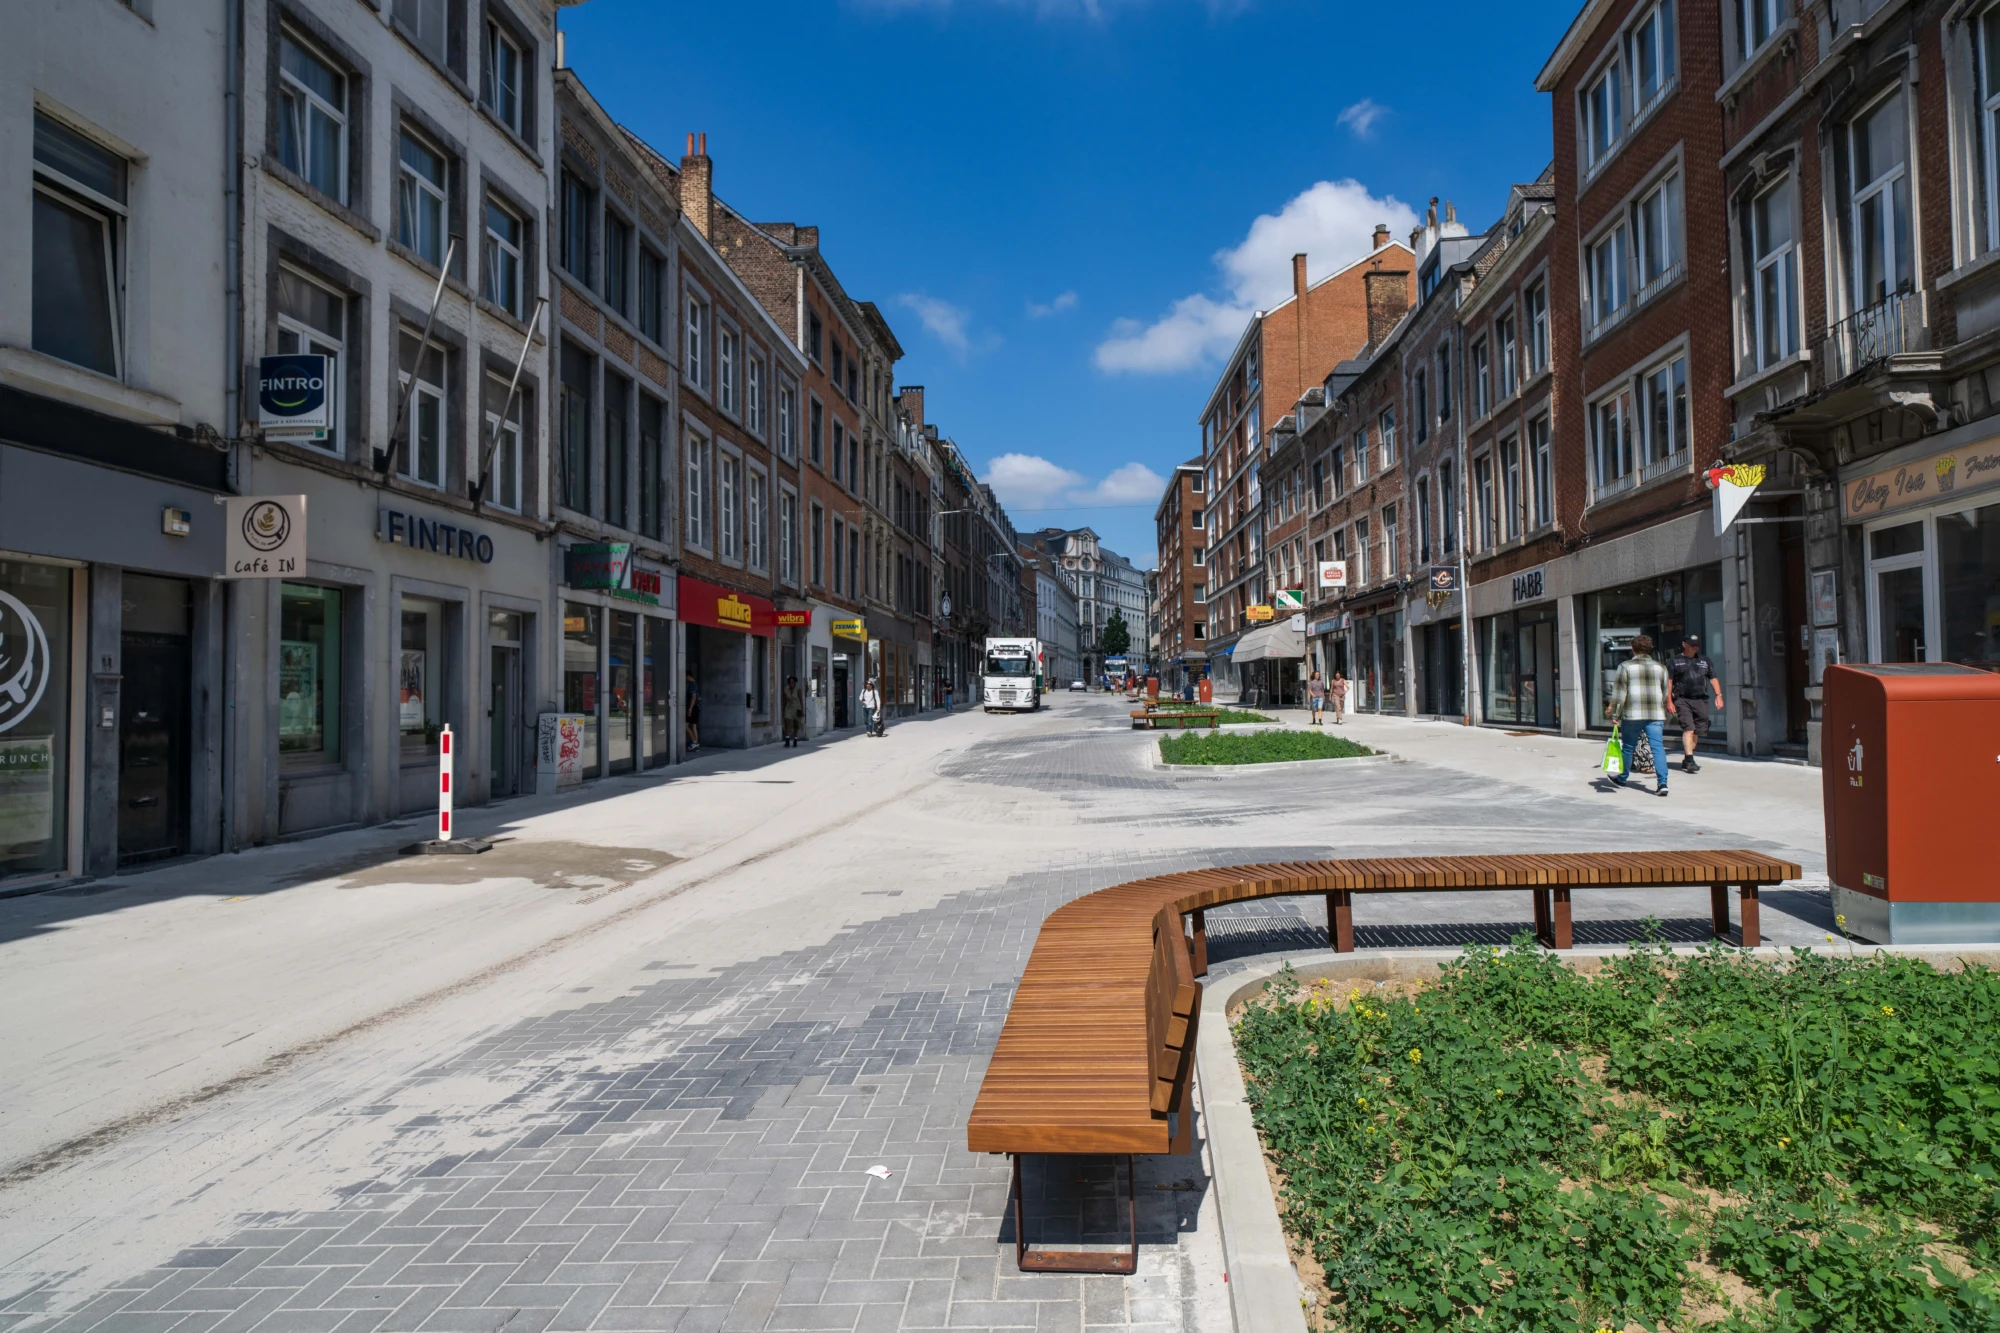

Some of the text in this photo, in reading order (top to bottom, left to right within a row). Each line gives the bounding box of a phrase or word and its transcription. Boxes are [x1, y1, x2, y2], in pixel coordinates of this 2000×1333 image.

[260, 377, 323, 392] FINTRO
[1852, 477, 1890, 512] Chez
[1895, 467, 1926, 496] Isa
[388, 510, 494, 564] FINTRO
[234, 556, 295, 573] Café IN
[1513, 571, 1543, 601] HABB
[717, 594, 752, 622] wibra
[778, 614, 805, 622] wibra
